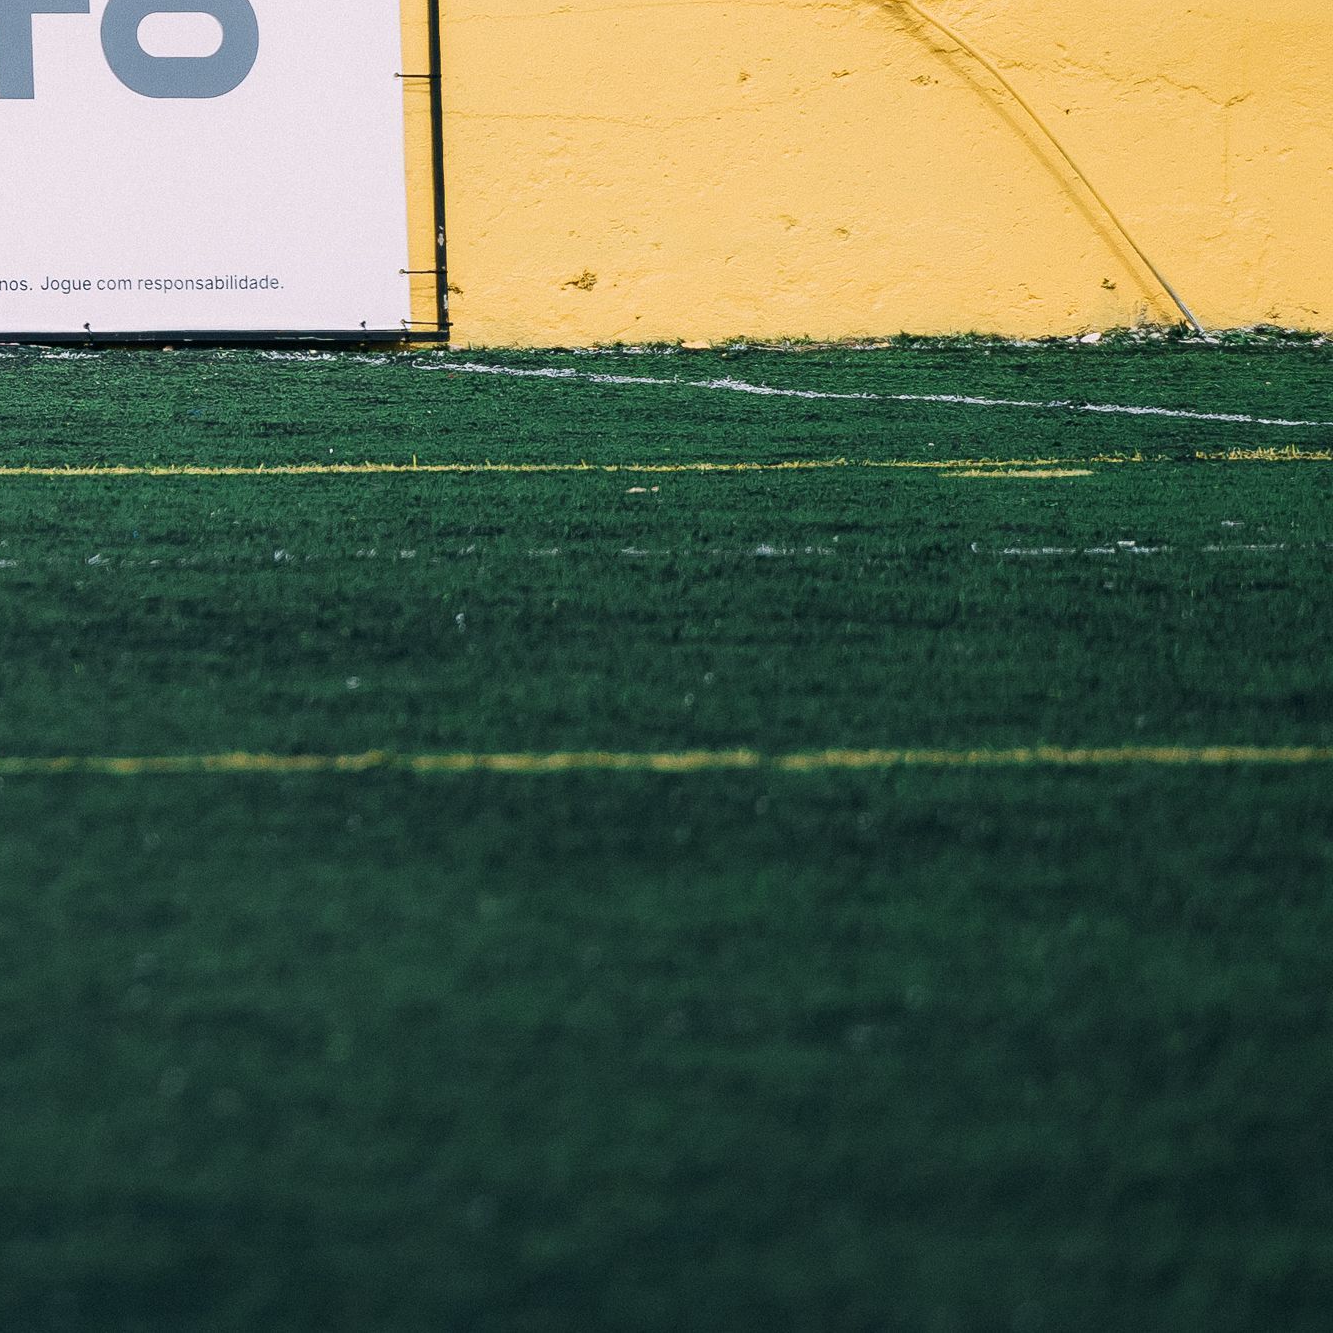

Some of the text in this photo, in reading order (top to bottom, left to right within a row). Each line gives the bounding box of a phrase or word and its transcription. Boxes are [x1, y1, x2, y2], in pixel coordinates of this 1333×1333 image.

[40, 276, 93, 296] Jogue
[97, 279, 133, 292] com
[138, 275, 285, 295] responsabilidade.
